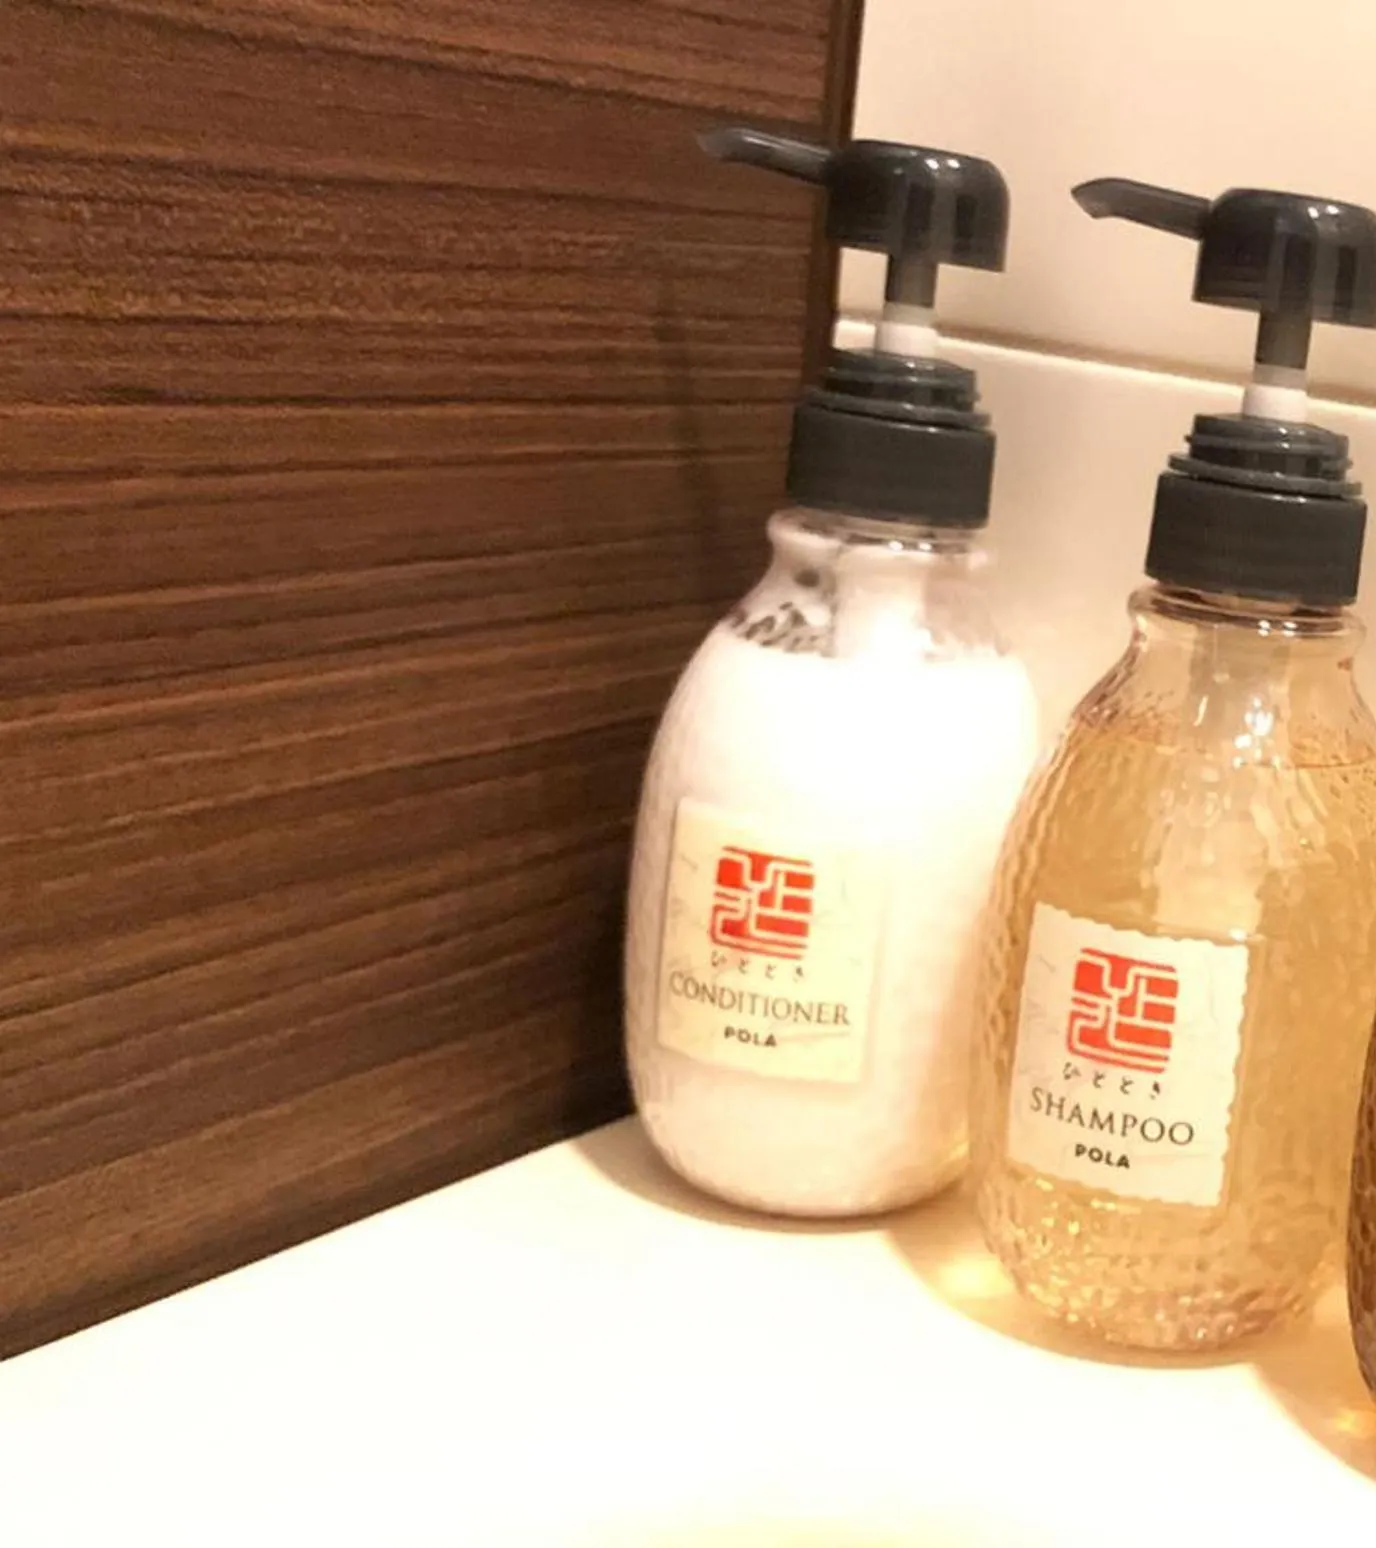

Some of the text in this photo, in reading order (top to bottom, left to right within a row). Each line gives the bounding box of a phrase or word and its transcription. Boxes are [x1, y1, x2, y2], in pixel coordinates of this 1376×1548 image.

[669, 970, 850, 1026] CONDITIONER
[724, 1025, 777, 1047] POLA
[1029, 1086, 1195, 1146] SHAMPOO
[1074, 1143, 1130, 1169] POLA
